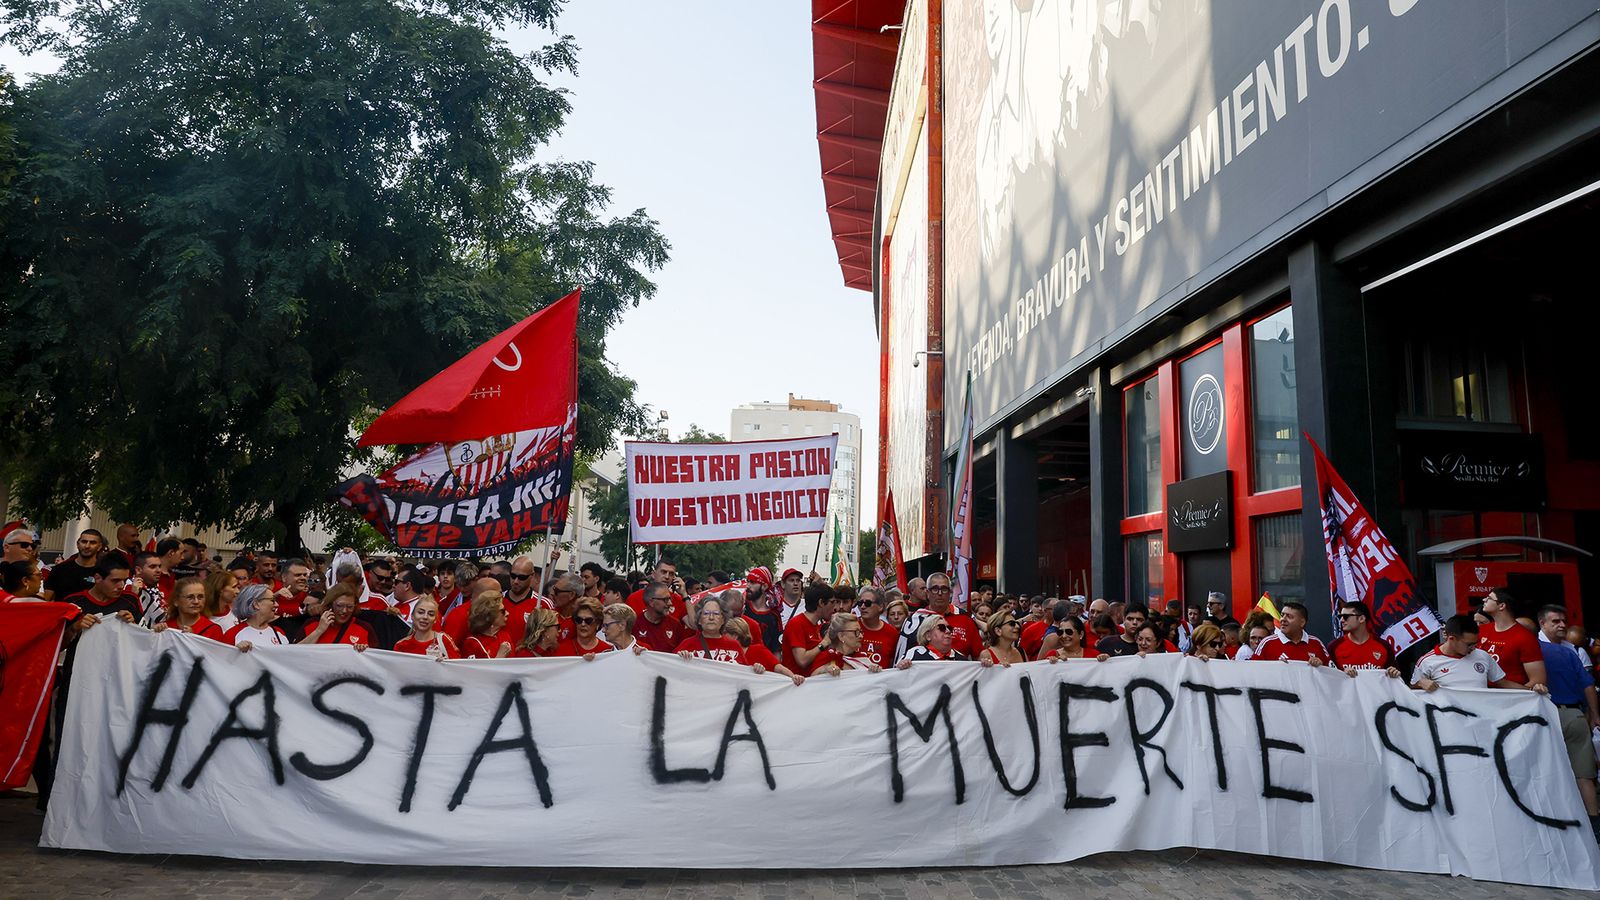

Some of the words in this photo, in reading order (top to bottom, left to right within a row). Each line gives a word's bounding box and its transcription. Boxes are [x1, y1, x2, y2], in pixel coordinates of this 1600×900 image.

[968, 312, 1014, 383] LEYENDA,
[1016, 236, 1091, 342] BRAVURA
[1094, 214, 1109, 273] Y
[1115, 0, 1370, 257] SENTIMIENTO.
[634, 454, 741, 484] NUESTRA
[749, 447, 831, 480] PASION
[1441, 453, 1510, 475] Premier
[635, 493, 743, 528] VUESTRO
[745, 488, 830, 522] NEGOCIO
[116, 651, 553, 813] HASTA
[652, 676, 776, 790] LA
[886, 676, 1314, 810] MUERTE
[1374, 700, 1582, 830] SFC
